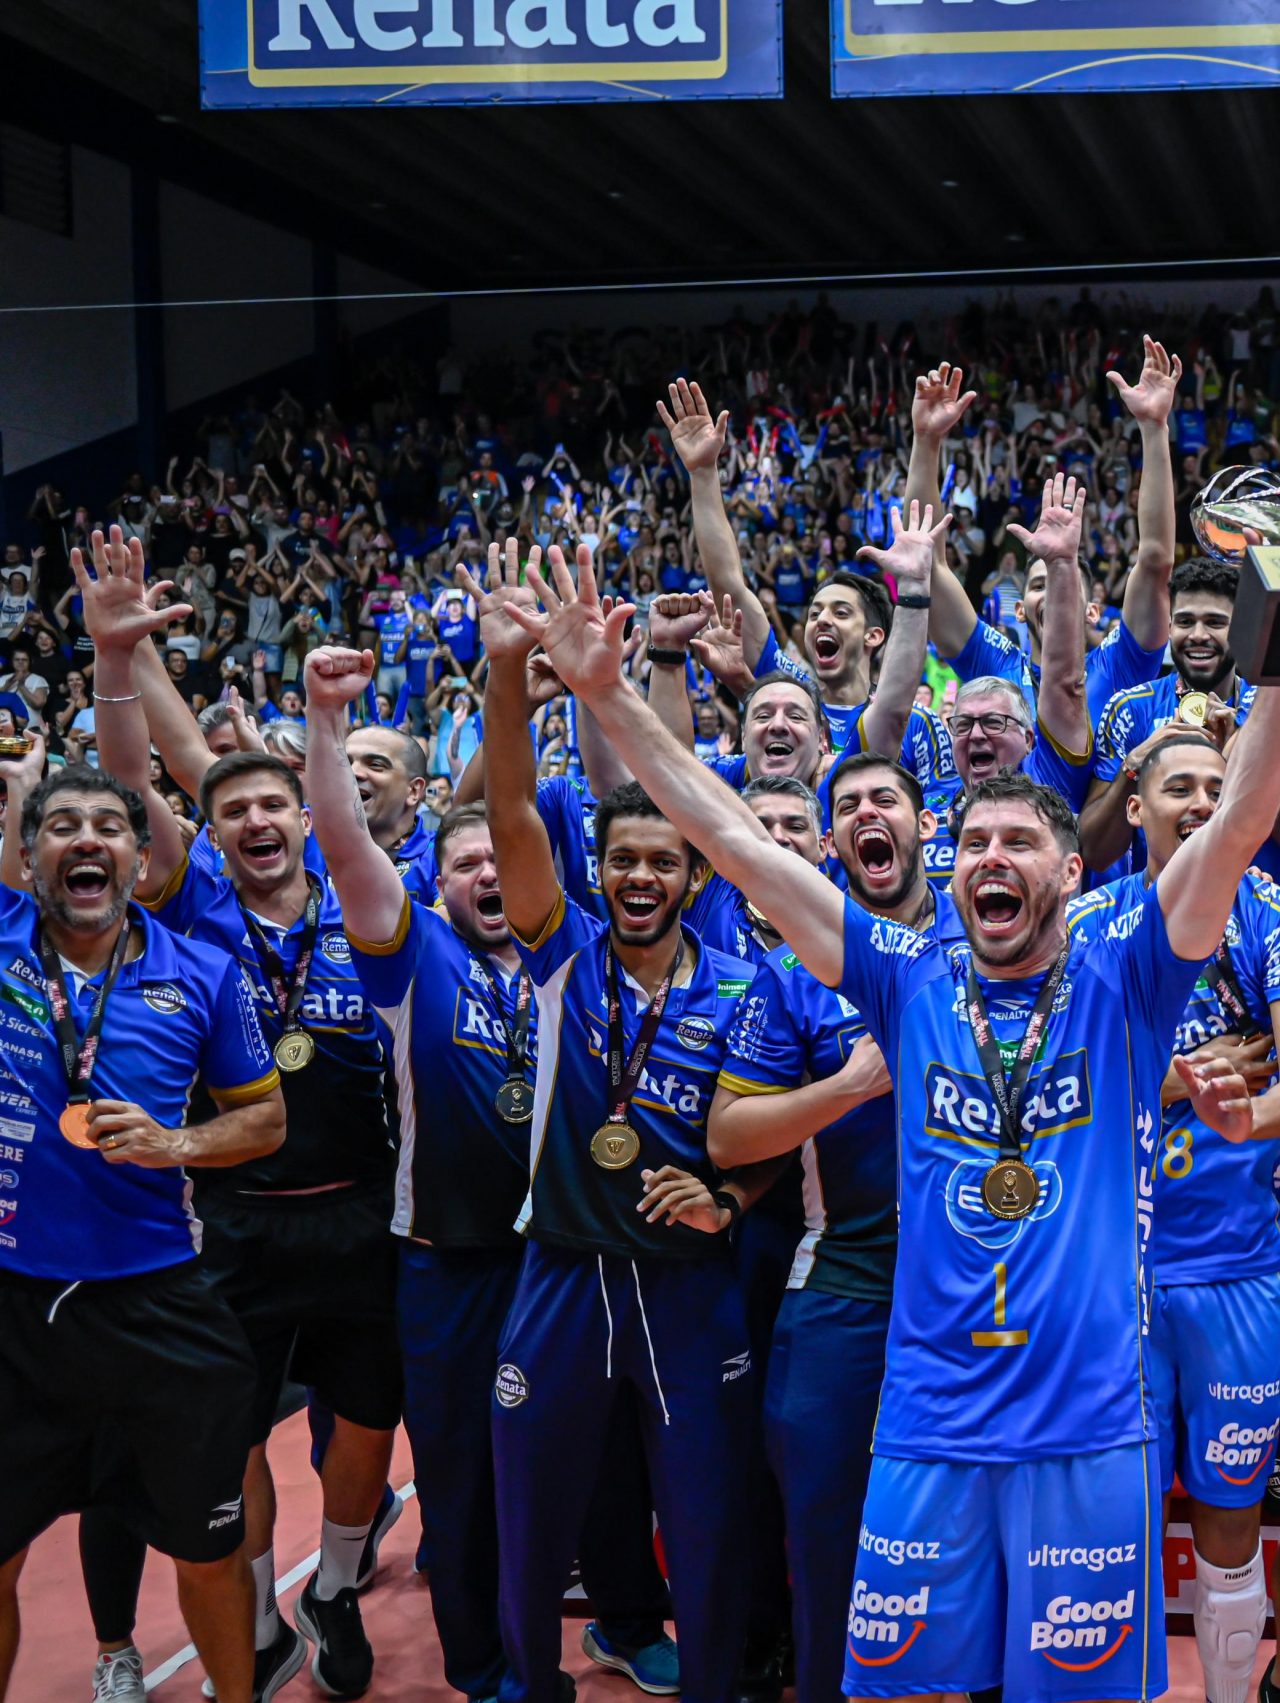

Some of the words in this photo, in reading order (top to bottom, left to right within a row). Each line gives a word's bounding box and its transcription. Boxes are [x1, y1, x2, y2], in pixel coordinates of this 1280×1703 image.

[321, 940, 350, 953] Rena
[870, 922, 929, 957] ADERE
[989, 1010, 1031, 1021] PENALTY
[676, 1024, 713, 1041] Renata
[0, 1038, 43, 1060] ANASA
[0, 1092, 31, 1109] VER
[933, 1075, 1082, 1134] Reata
[992, 1263, 1007, 1325] 1
[497, 1376, 527, 1398] Renata
[1208, 1379, 1280, 1404] ultragaz
[1220, 1417, 1280, 1446] Good
[1205, 1440, 1261, 1466] Bom
[208, 1509, 241, 1530] PENAL
[1028, 1544, 1136, 1572] ultragaz
[853, 1579, 930, 1616] Good
[1046, 1590, 1135, 1624] Good
[847, 1602, 899, 1643] Bom
[1030, 1621, 1107, 1651] Bom
